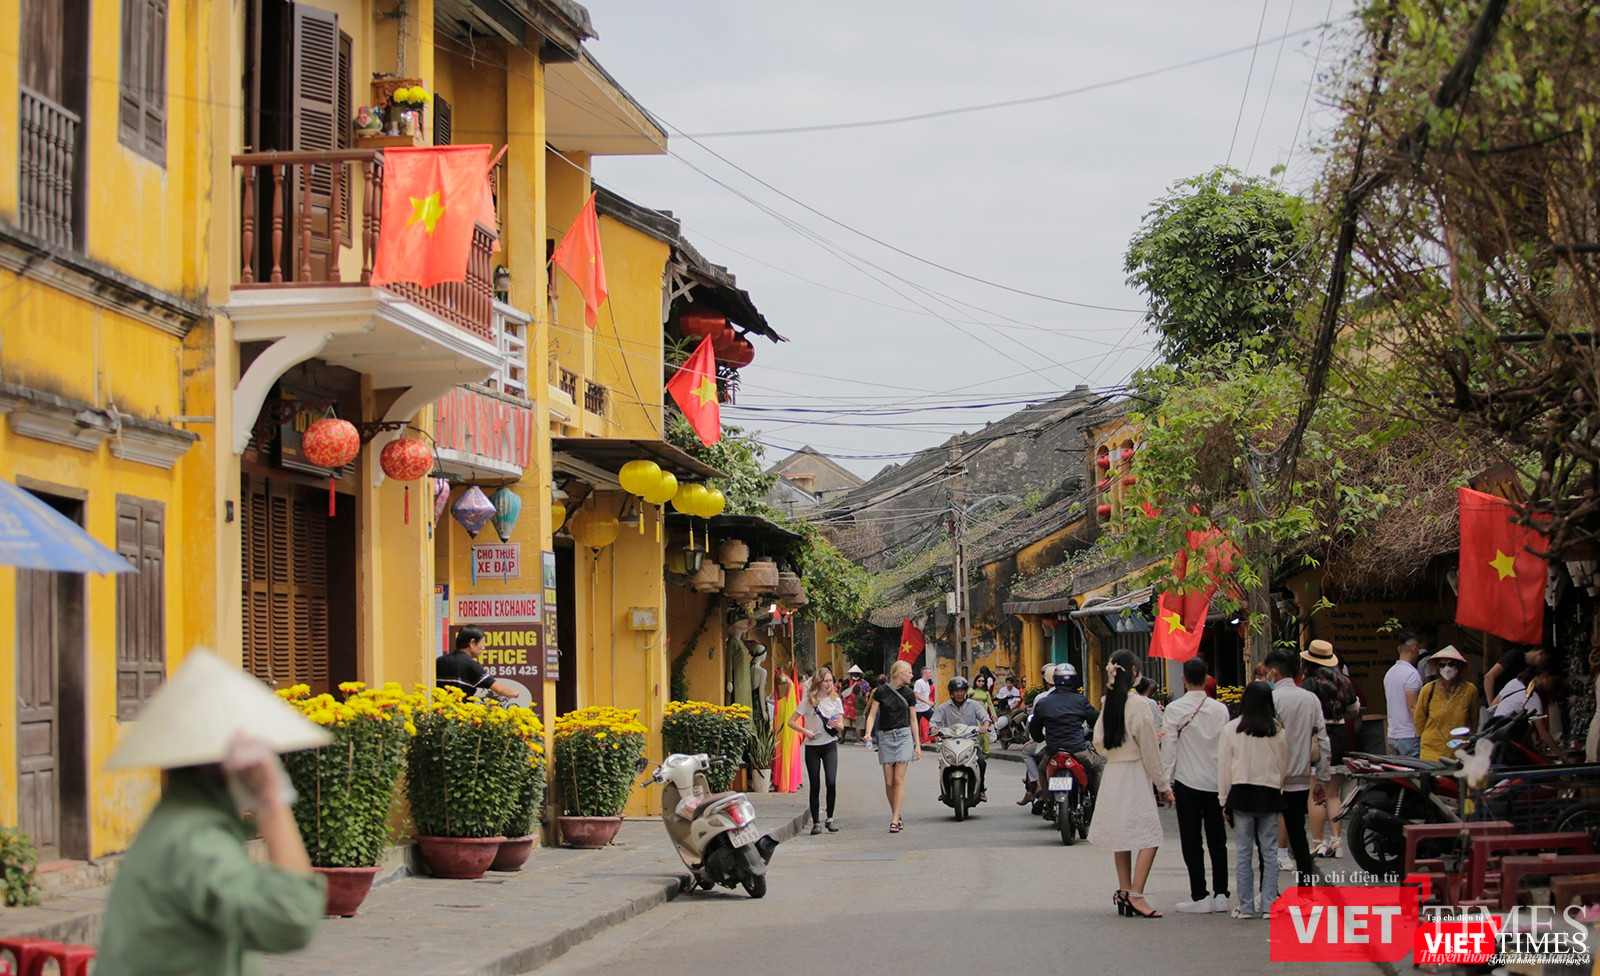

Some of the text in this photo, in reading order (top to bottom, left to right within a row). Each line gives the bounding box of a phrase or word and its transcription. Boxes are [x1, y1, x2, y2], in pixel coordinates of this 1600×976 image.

[477, 547, 515, 560] CHO THUÊ
[478, 562, 491, 573] XE
[458, 600, 536, 617] FOREIGN EXCHANGE
[455, 631, 537, 646] OKING
[474, 649, 527, 665] FFICE
[499, 666, 516, 676] 561
[519, 665, 538, 675] 425
